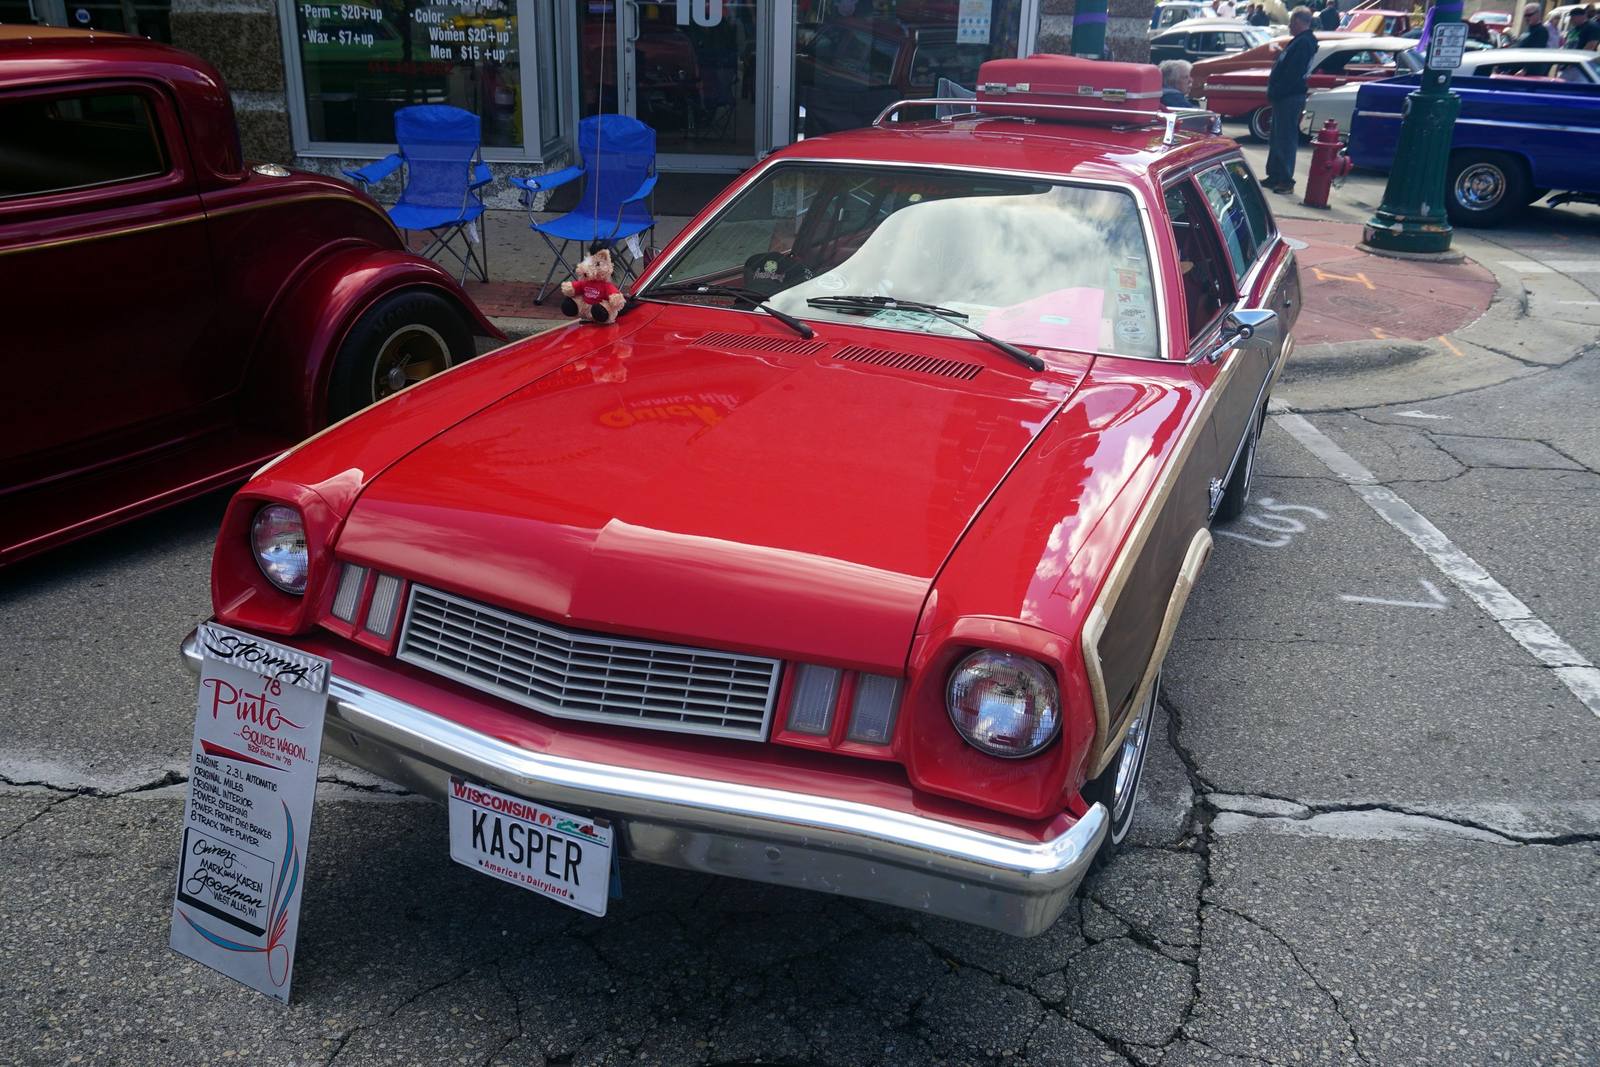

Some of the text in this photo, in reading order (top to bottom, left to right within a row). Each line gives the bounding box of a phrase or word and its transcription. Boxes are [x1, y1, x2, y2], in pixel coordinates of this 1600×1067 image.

[304, 4, 331, 19] Perm
[341, 5, 382, 23] $20+up
[415, 9, 445, 24] Color:
[307, 31, 329, 44] Wax
[338, 30, 374, 48] $7+up
[429, 27, 465, 41] Women
[430, 44, 452, 59] Men
[203, 678, 308, 731] Pinto
[193, 777, 254, 810] ORIGINAL INTERIOR
[194, 766, 244, 792] ORIGINAL MILES
[245, 773, 277, 792] AUTOMATIC
[192, 788, 248, 818] POWER STEERING
[452, 782, 538, 822] WISCONSIN
[190, 810, 260, 847] 8 TRACK TAPE PLAYER
[191, 798, 214, 816] POWER
[214, 809, 235, 824] FRONT
[249, 823, 272, 840] BRAKES
[472, 808, 583, 886] KASPER
[200, 858, 225, 878] MARK
[236, 873, 263, 894] KAREN
[484, 860, 568, 897] America's Dairyland
[213, 890, 231, 905] WEST
